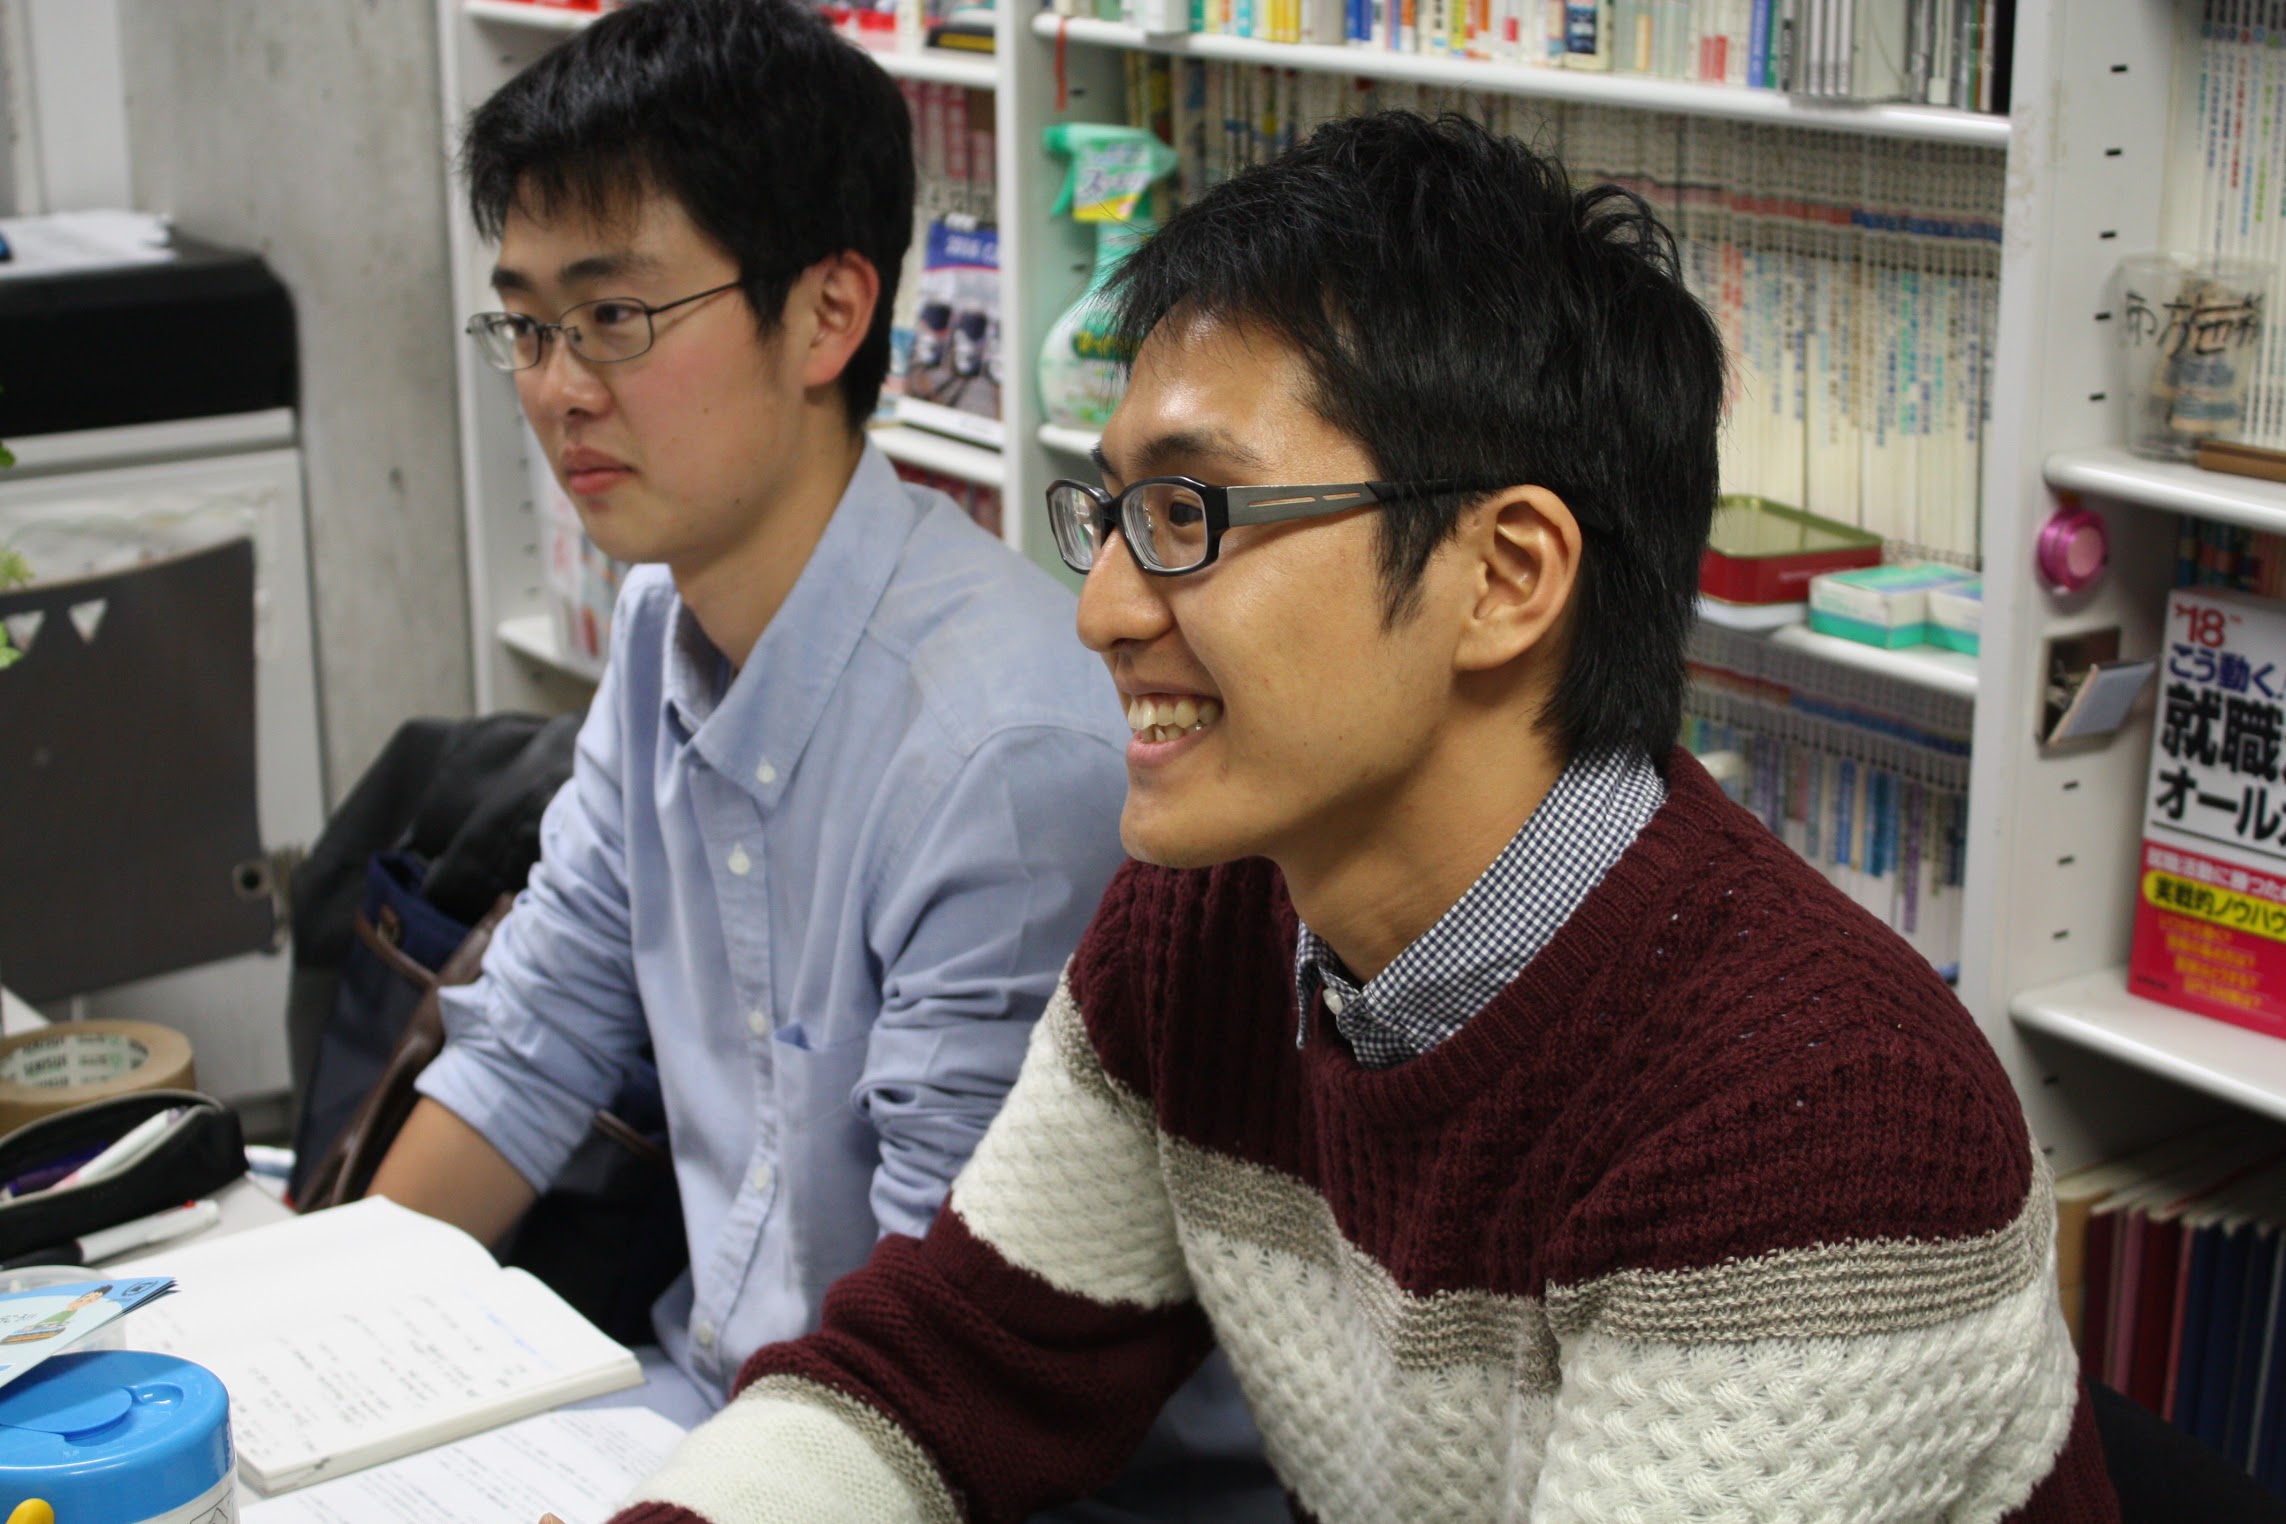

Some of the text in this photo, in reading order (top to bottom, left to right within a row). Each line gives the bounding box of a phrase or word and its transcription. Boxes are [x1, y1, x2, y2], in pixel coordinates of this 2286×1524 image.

[2160, 682, 2286, 783] 就職
[2155, 766, 2286, 847] オール
